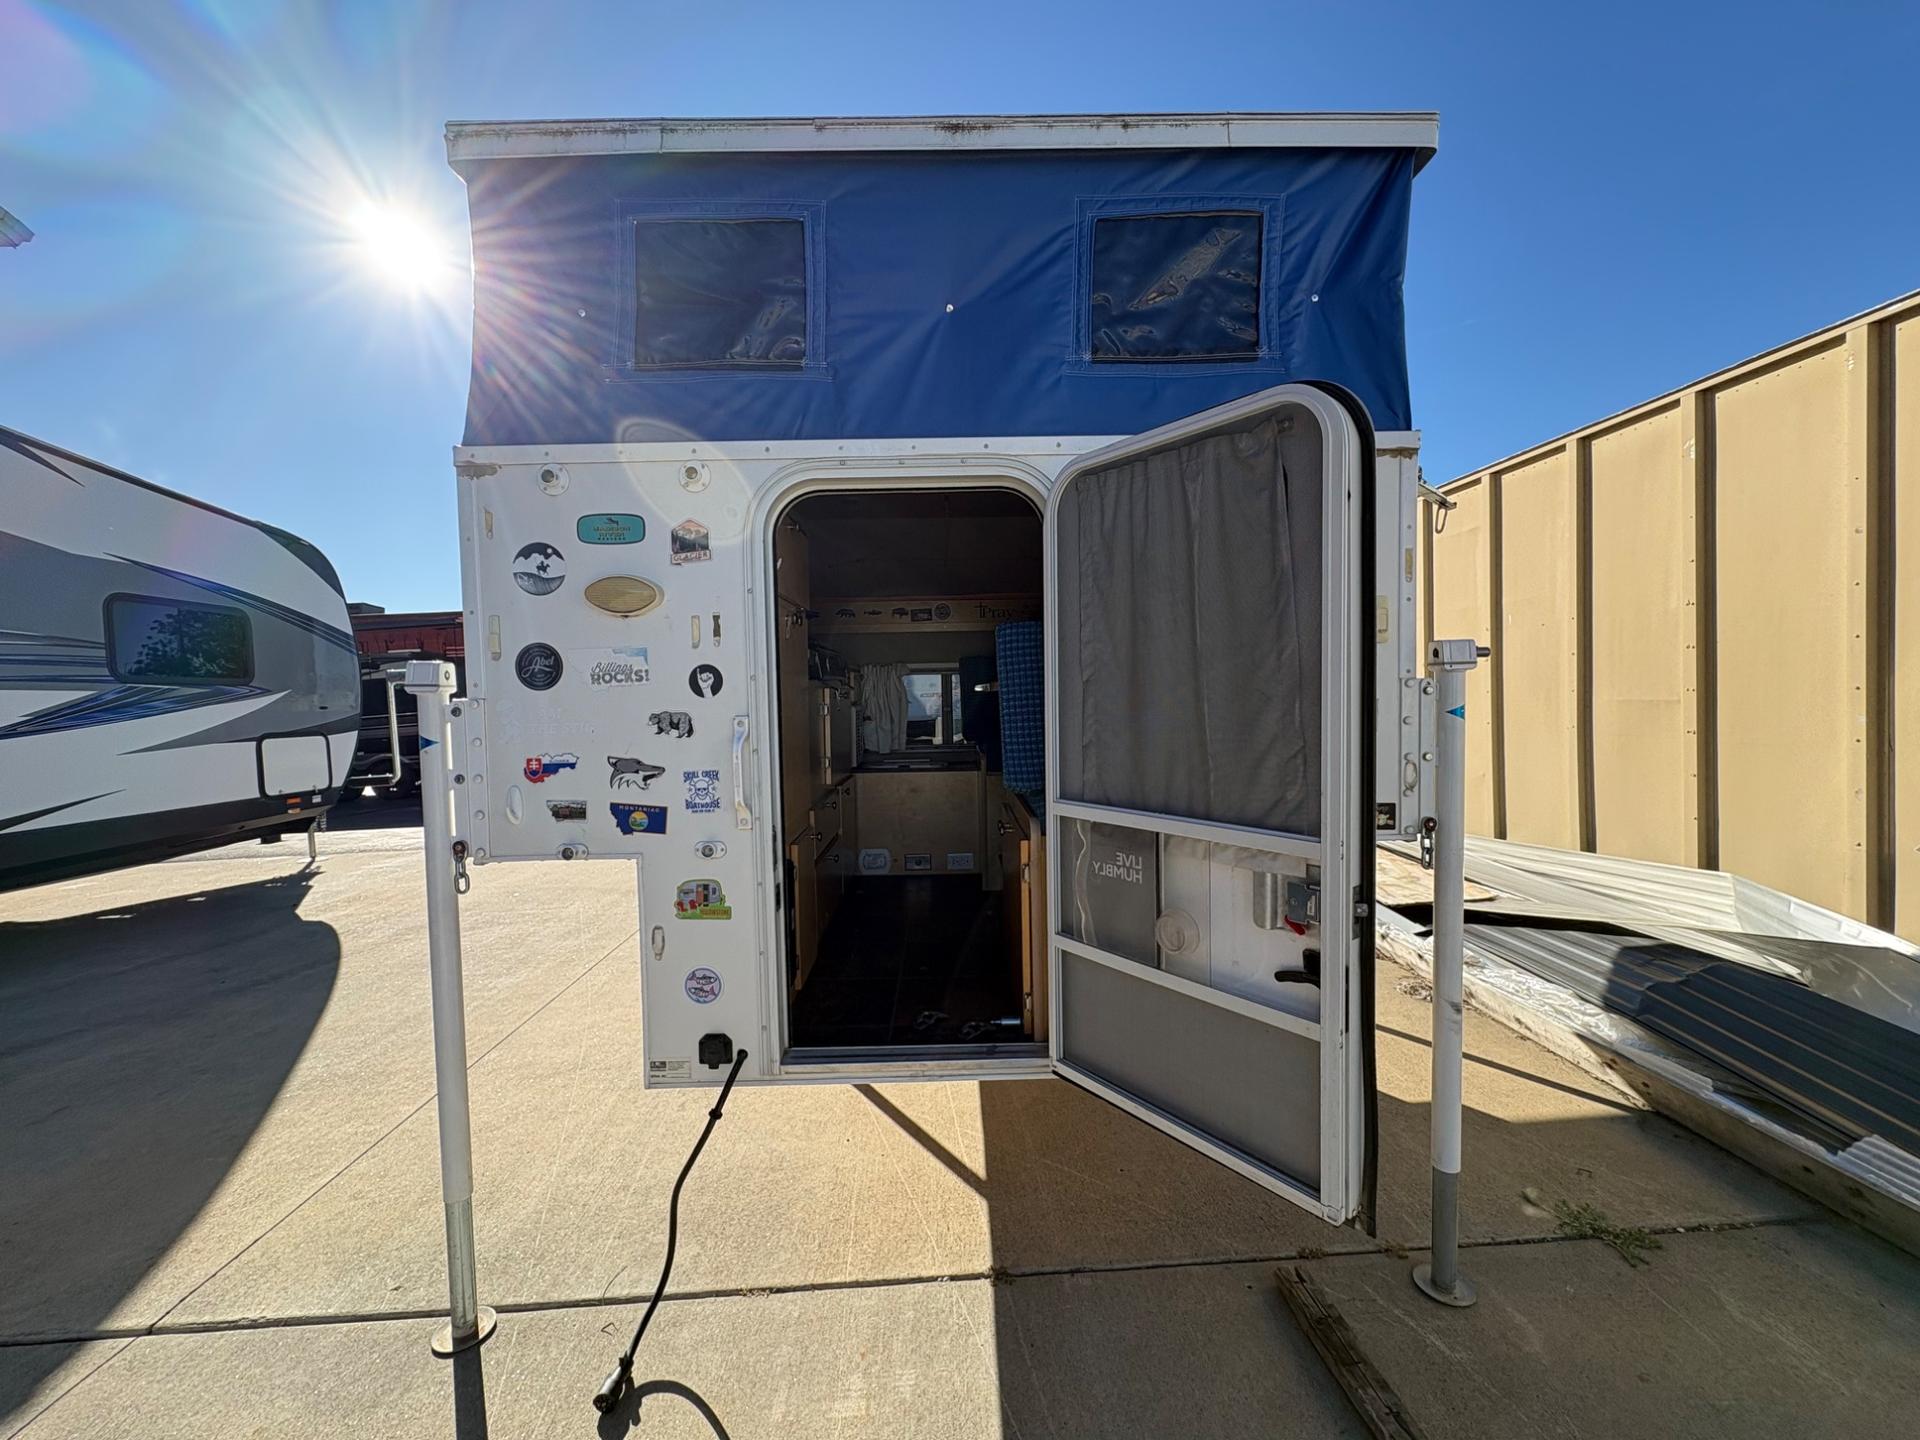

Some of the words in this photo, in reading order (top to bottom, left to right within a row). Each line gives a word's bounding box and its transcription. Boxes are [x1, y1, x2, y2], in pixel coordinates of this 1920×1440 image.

[673, 551, 709, 562] GLACIER
[981, 607, 1016, 620] Pray
[521, 656, 555, 678] Abel
[591, 661, 633, 673] Billings
[590, 668, 650, 685] ROCKS!
[683, 771, 699, 783] SKULL
[701, 770, 719, 781] CREEK
[685, 797, 720, 809] BOATHOUSE
